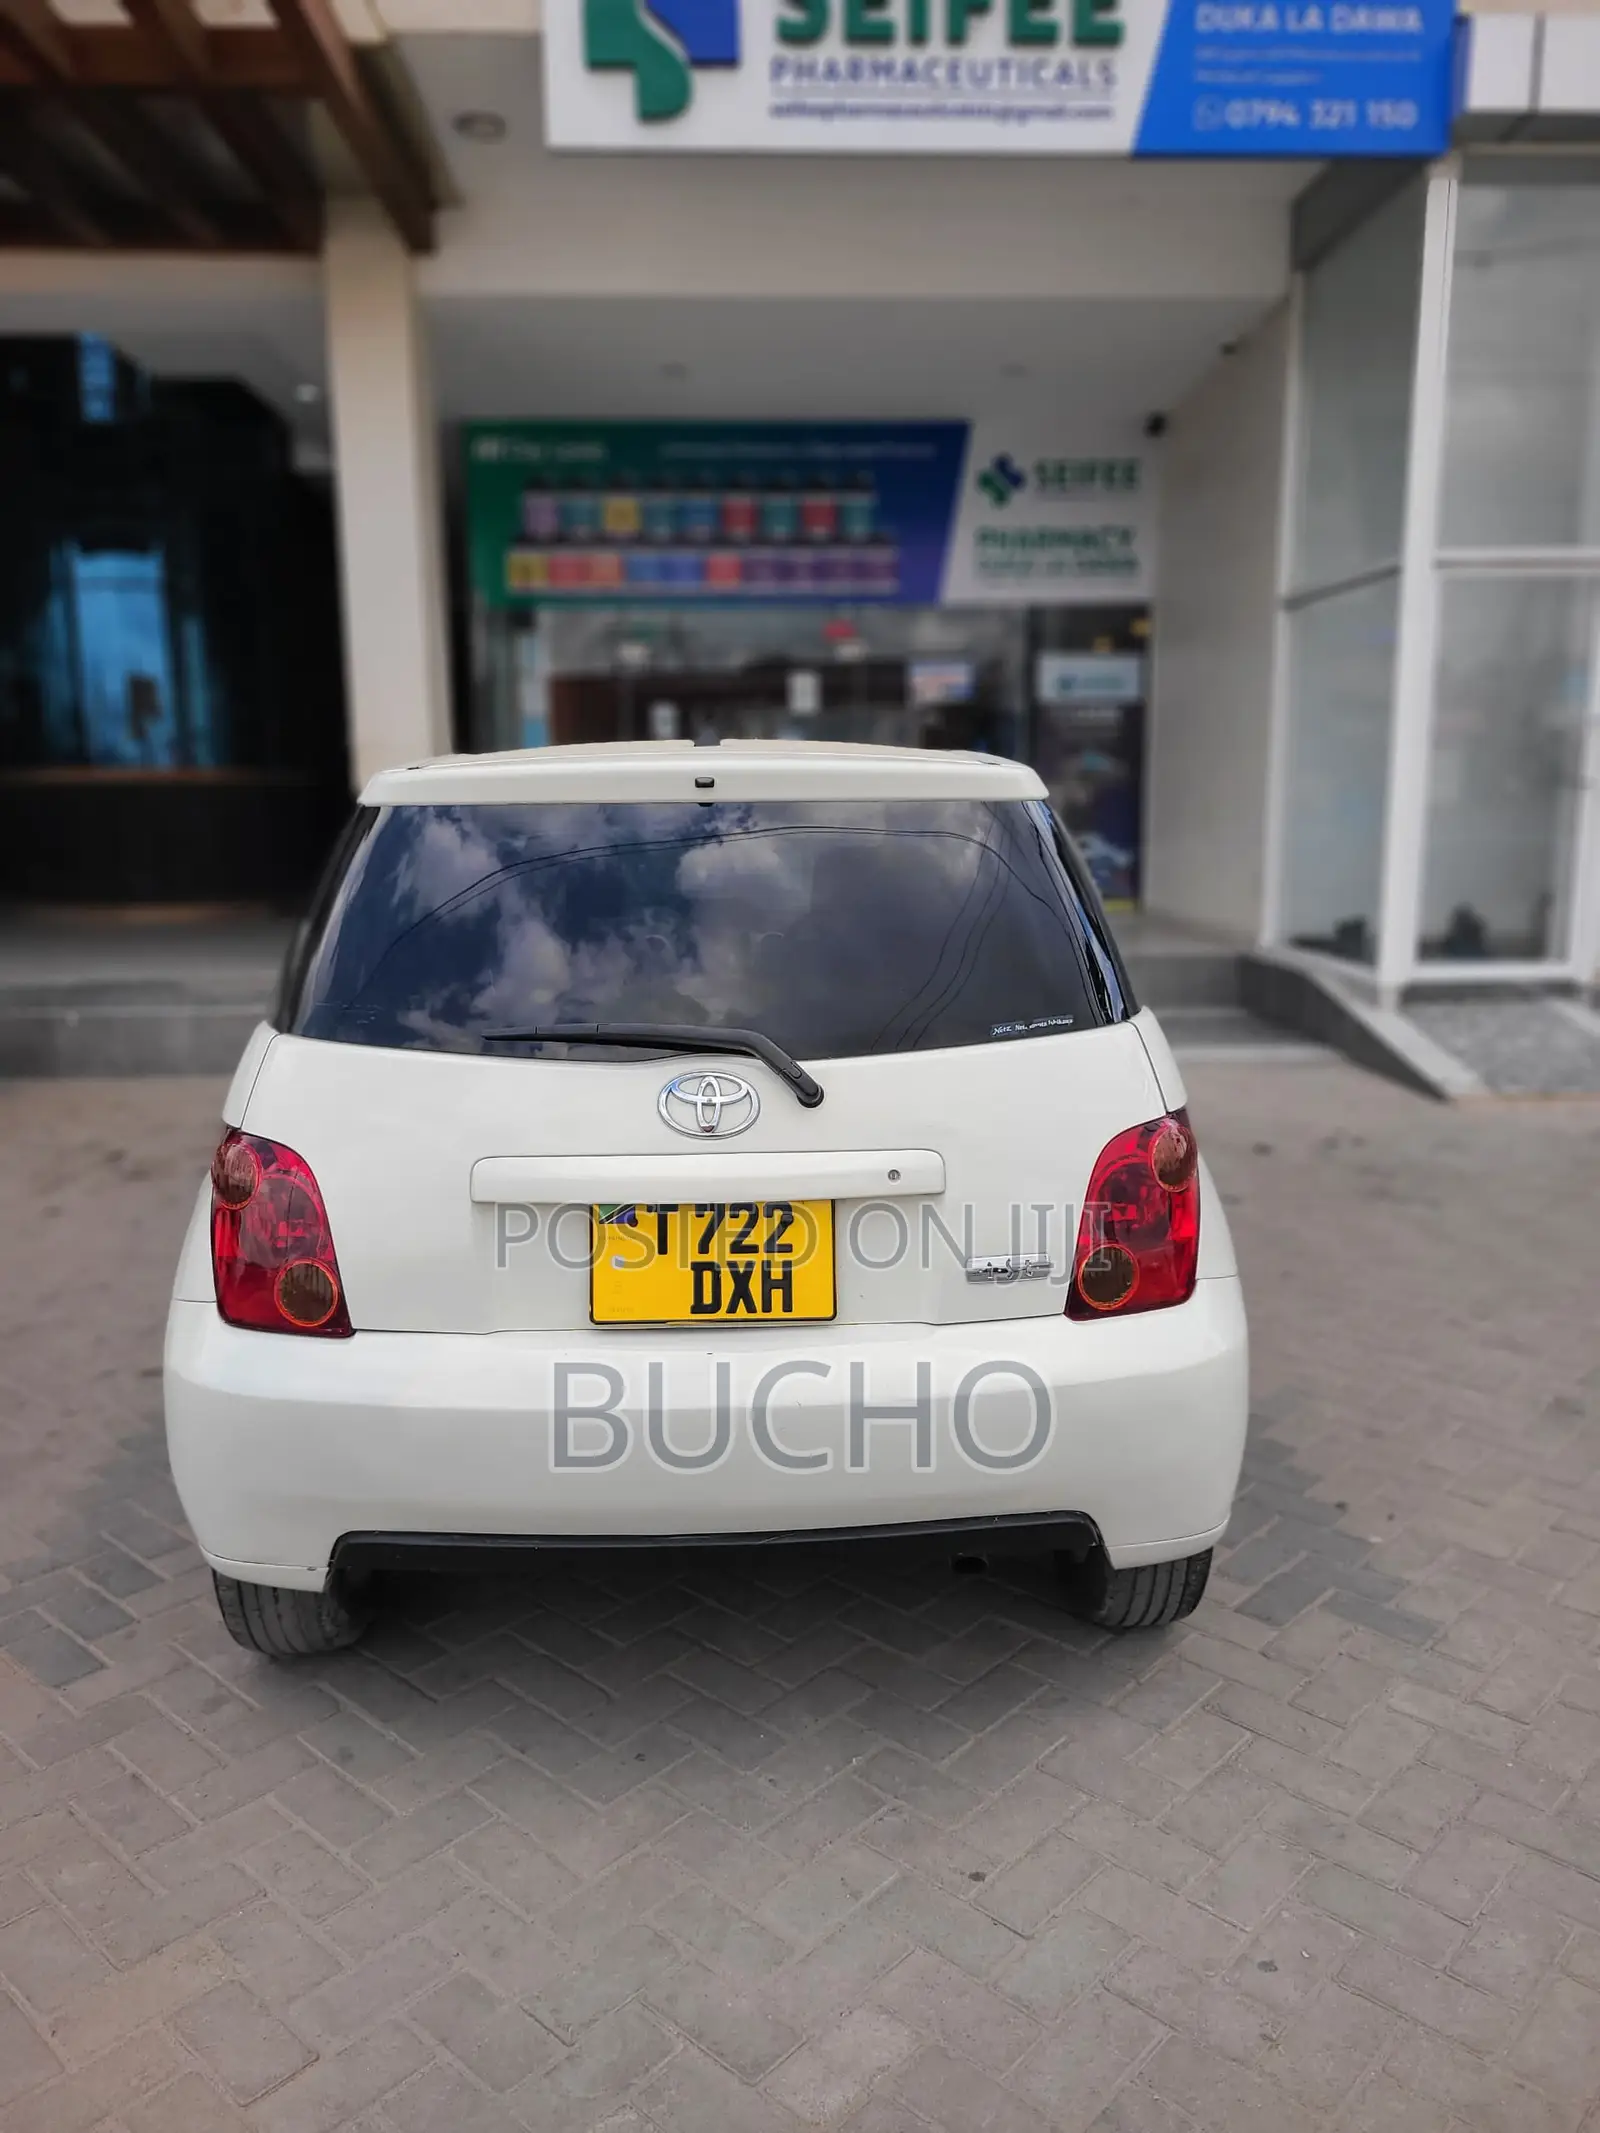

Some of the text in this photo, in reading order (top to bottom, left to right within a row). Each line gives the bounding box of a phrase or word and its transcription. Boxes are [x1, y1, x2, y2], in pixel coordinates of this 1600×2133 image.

[1196, 5, 1422, 32] DUKA LA DAWA
[769, 56, 1118, 88] PHARMACEUTICALS
[648, 1202, 794, 1255] T 722
[690, 1259, 794, 1315] DXH
